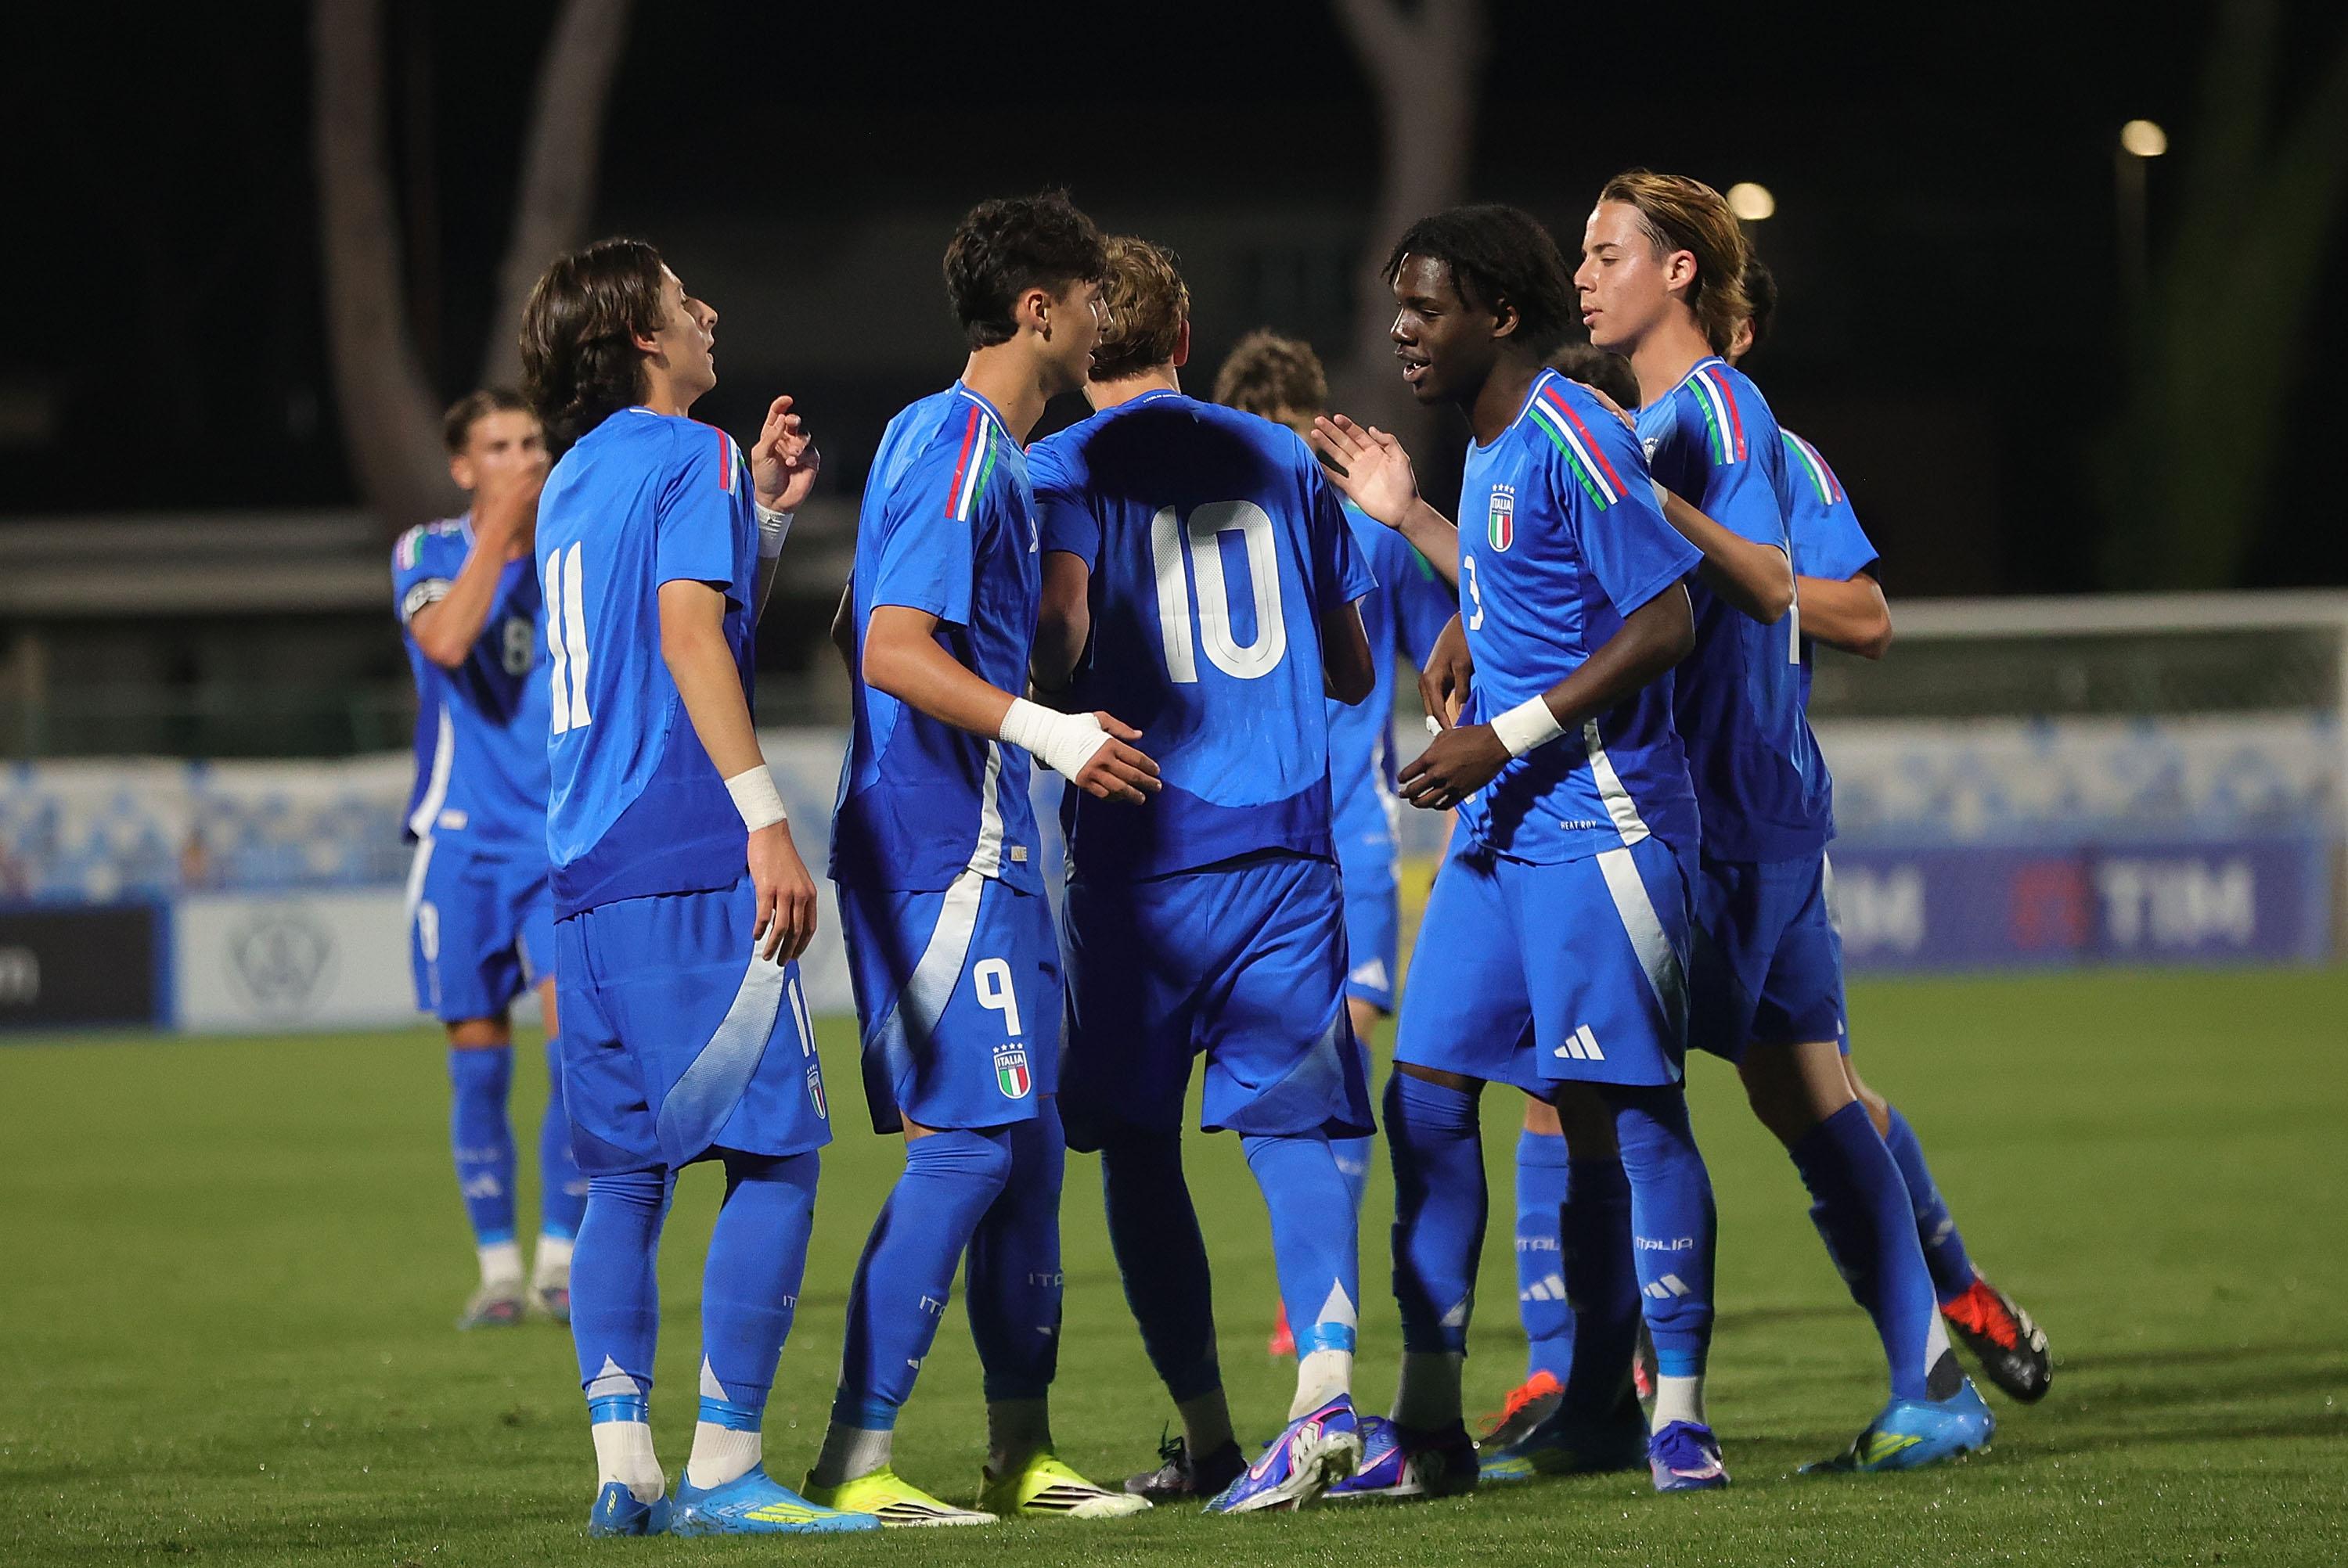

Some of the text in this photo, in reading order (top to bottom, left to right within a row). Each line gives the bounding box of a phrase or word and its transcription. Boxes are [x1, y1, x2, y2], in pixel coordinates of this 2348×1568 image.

[1151, 499, 1287, 684] 10
[1464, 555, 1485, 631] 3
[502, 616, 535, 677] 8
[545, 541, 592, 735] 11
[2102, 858, 2256, 948] TIM
[973, 957, 1021, 1037] 9
[996, 1053, 1024, 1067] ITALIA
[1637, 1236, 1694, 1250] ITALIA
